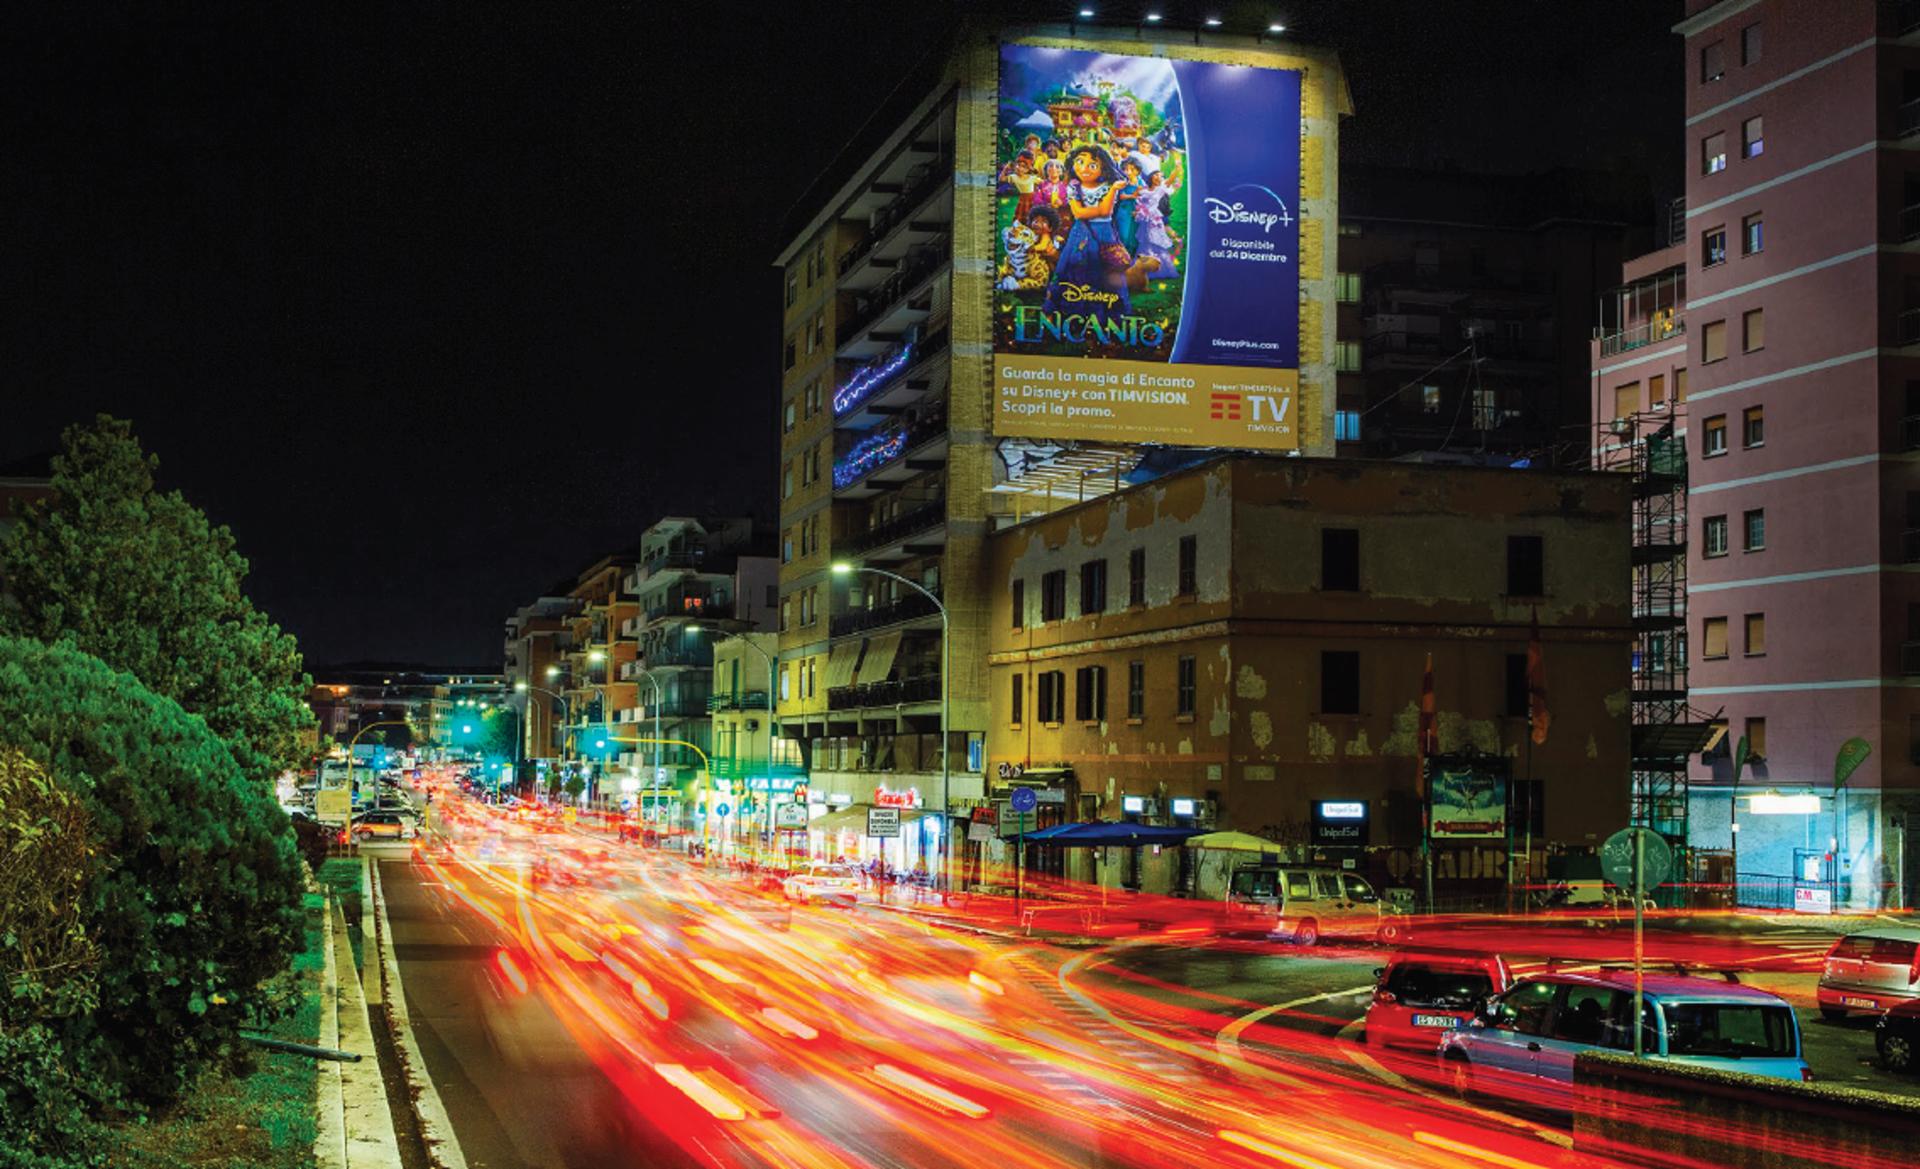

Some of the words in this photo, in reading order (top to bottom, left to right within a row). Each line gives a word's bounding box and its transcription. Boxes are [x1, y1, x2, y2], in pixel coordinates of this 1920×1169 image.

[1204, 197, 1294, 233] Disney+
[1221, 238, 1275, 249] Disponibile
[1209, 250, 1225, 258] dal
[1226, 250, 1239, 259] 24
[1240, 251, 1287, 263] Dicembre
[1058, 281, 1119, 309] Disney
[1014, 305, 1164, 347] ENCANTO
[1002, 366, 1055, 381] Guarda
[1058, 368, 1072, 382] la
[1075, 371, 1118, 386] magia
[1122, 372, 1135, 385] di
[1139, 374, 1196, 389] Encanto
[1002, 386, 1018, 397] su
[1022, 385, 1077, 402] Disney+
[1081, 389, 1106, 401] con
[1109, 388, 1190, 405] TIMVISION.
[1002, 401, 1047, 417] Scopri
[1050, 402, 1064, 415] la
[1067, 405, 1116, 418] promo.
[1247, 395, 1291, 422] TV
